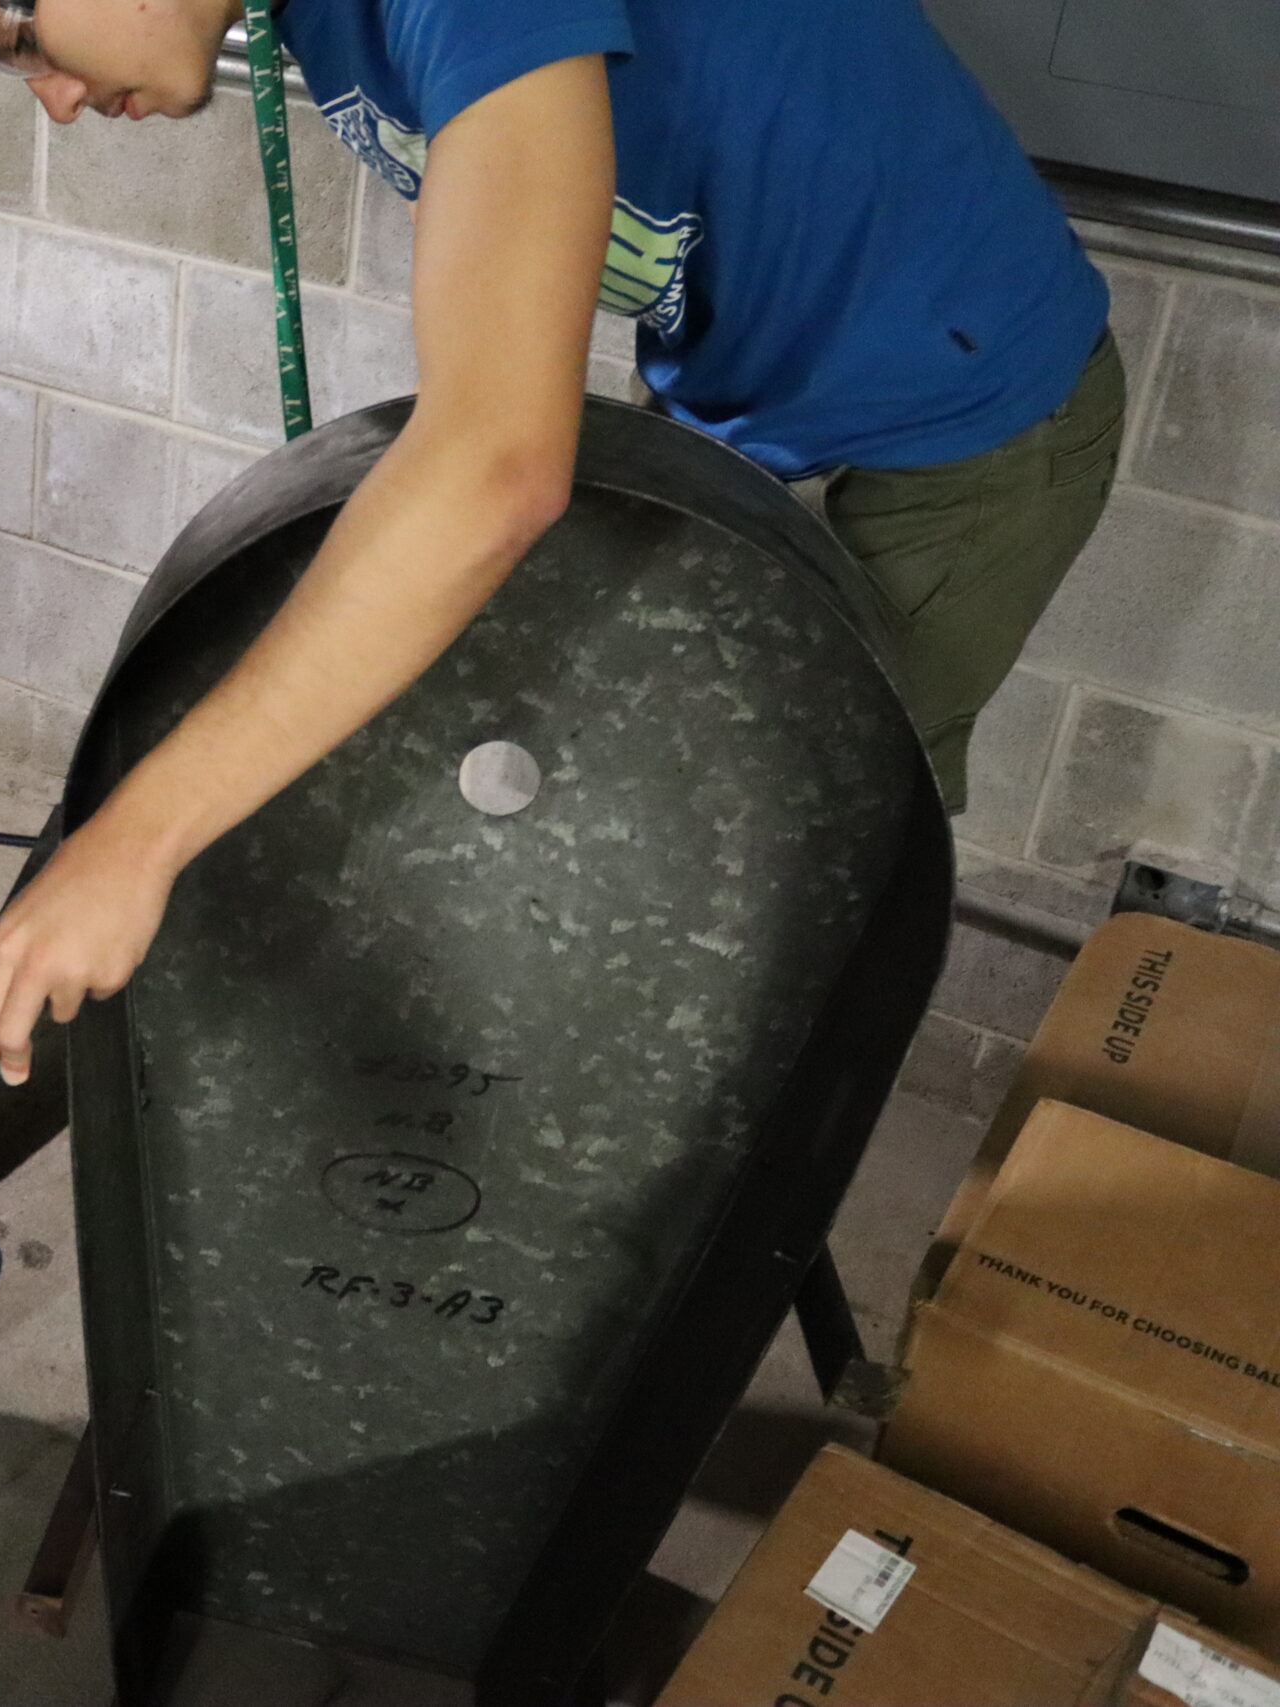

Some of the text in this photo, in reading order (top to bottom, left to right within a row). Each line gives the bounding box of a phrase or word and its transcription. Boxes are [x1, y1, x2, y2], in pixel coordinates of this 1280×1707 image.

[246, 6, 268, 42] VT
[253, 64, 272, 100] VT
[284, 394, 304, 427] VT
[1102, 949, 1173, 1065] THIS SIDE UP
[979, 1254, 1042, 1289] THANK
[1047, 1280, 1088, 1306] YOU
[1088, 1299, 1130, 1325] FOR
[1132, 1317, 1240, 1371] CHOOSING
